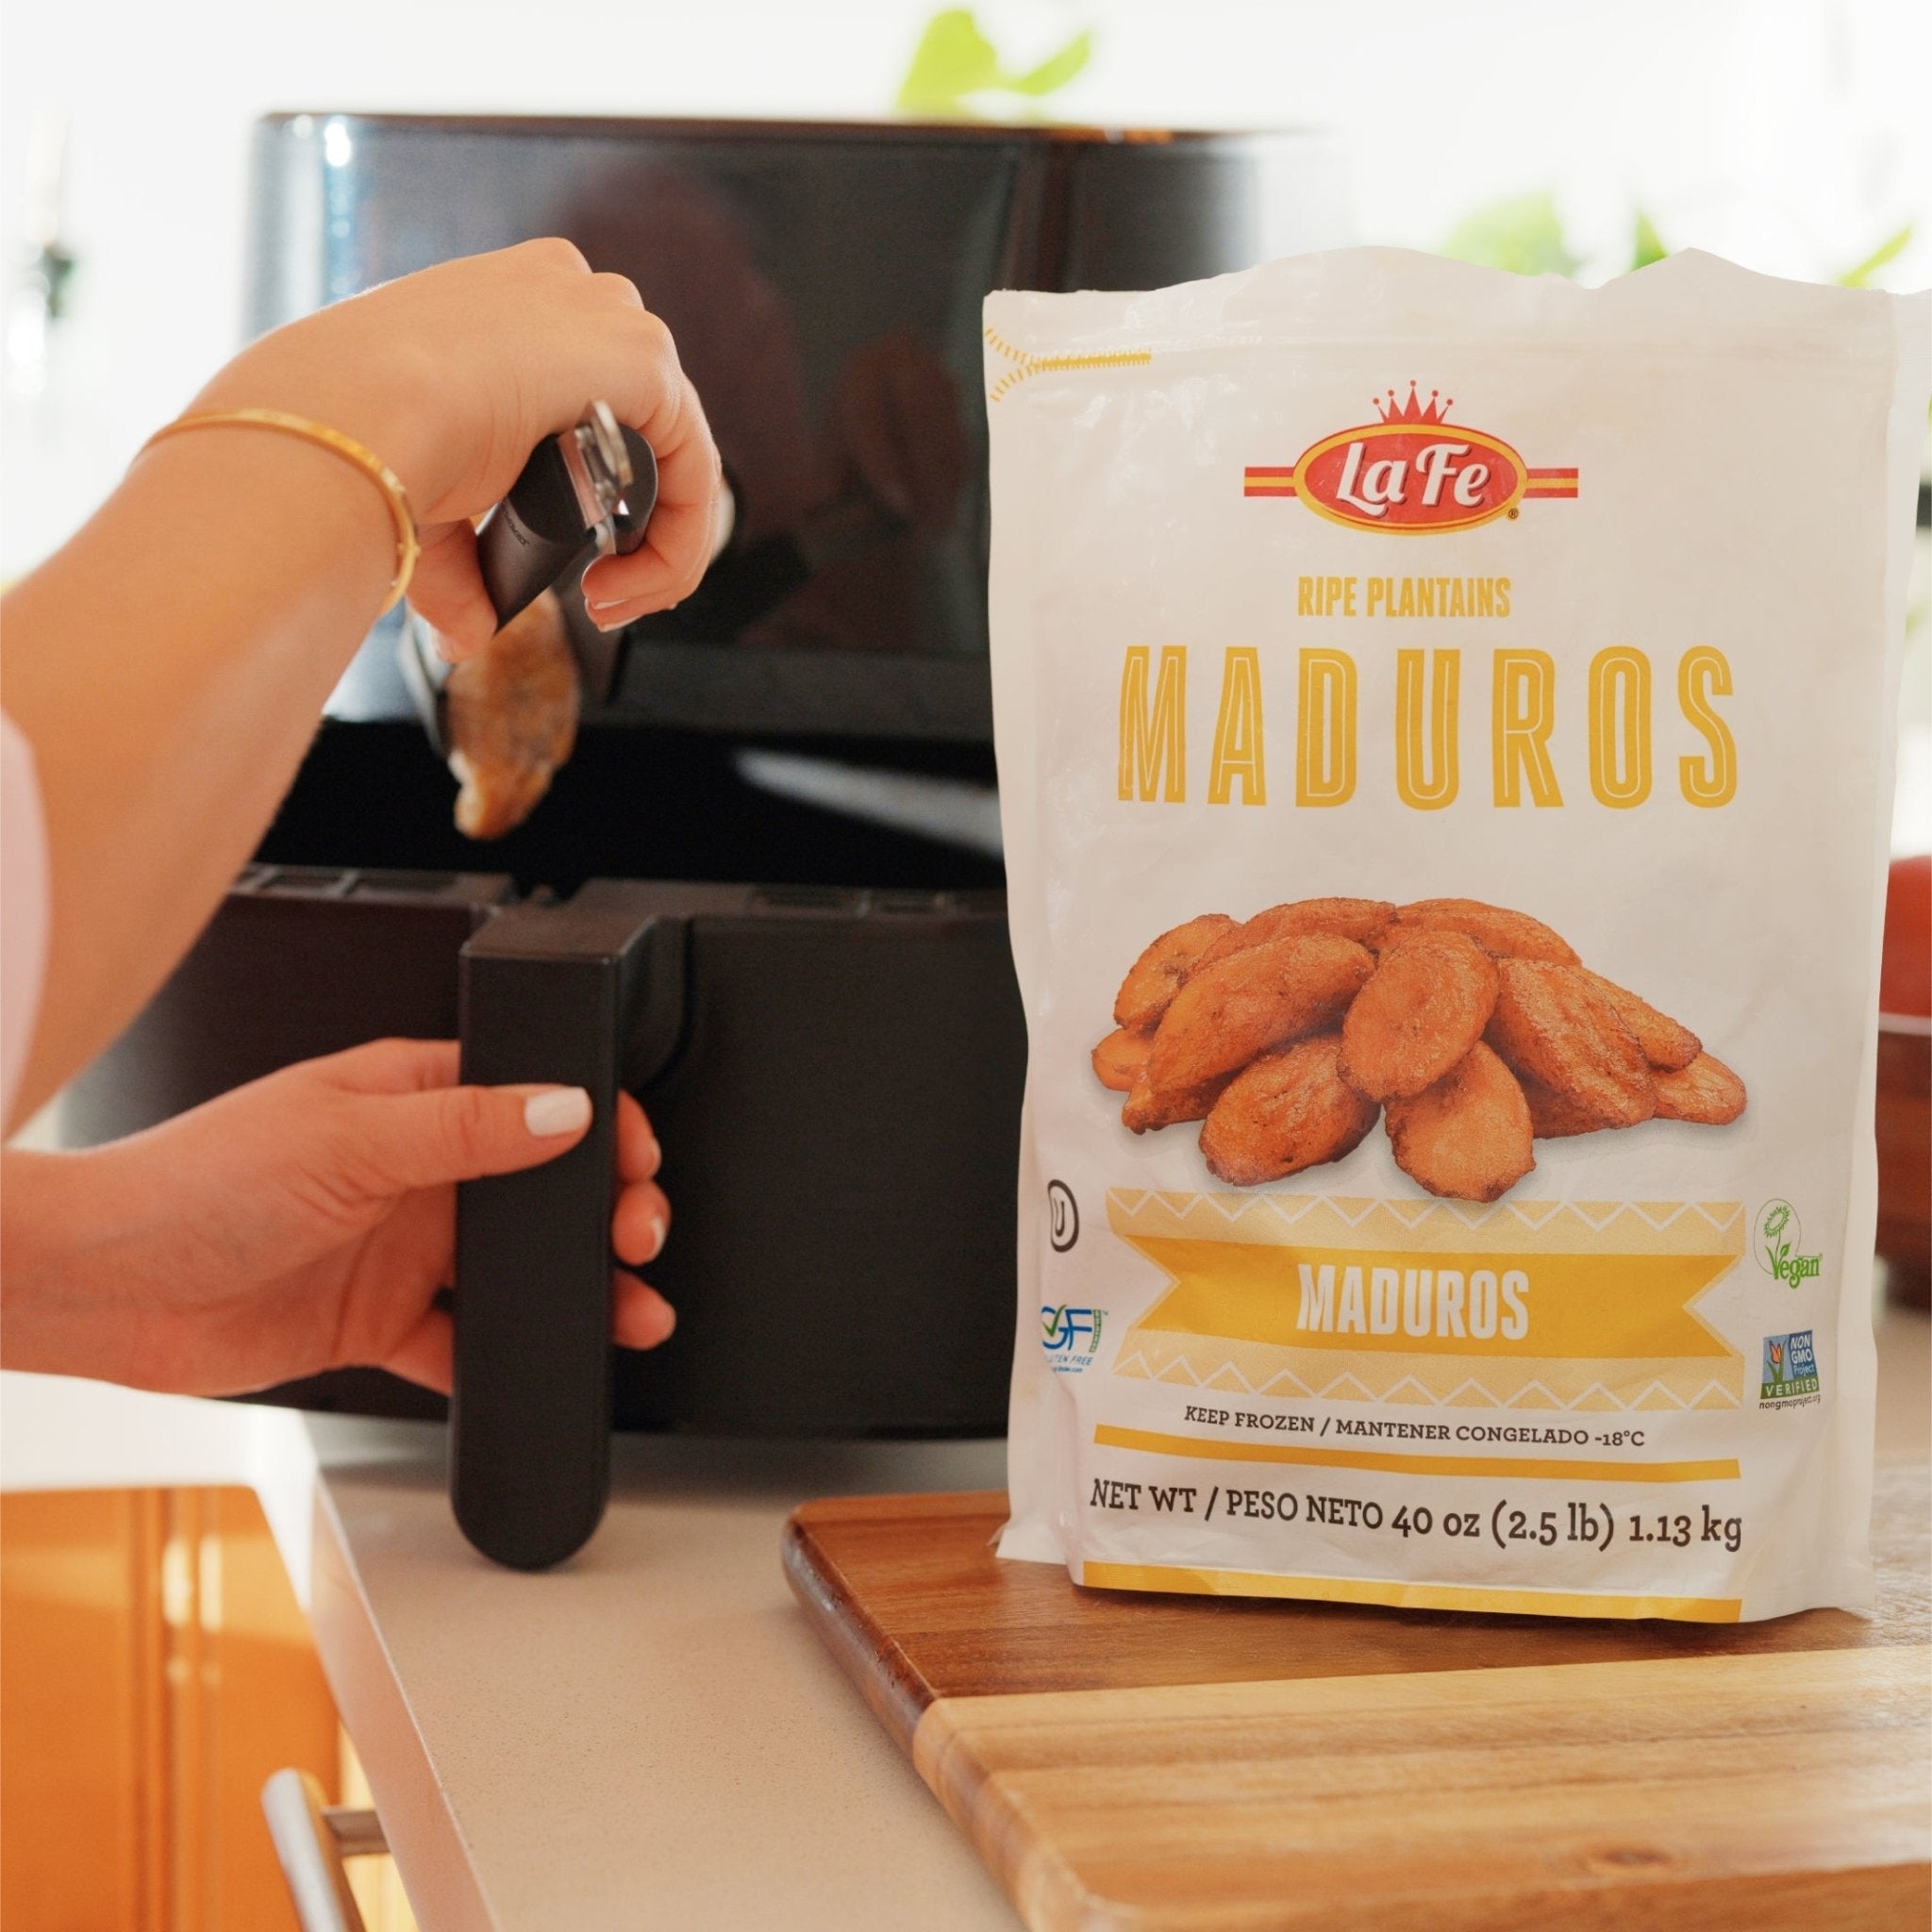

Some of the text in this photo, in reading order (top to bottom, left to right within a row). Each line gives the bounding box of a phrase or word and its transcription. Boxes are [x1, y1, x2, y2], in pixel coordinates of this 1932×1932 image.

[1336, 441, 1490, 518] La Fe
[1297, 576, 1512, 618] RIPE PLANTAINS
[1117, 644, 1738, 810] MADUROS
[1765, 1245, 1821, 1290] Vegan
[1296, 1263, 1530, 1341] MADUROS
[1071, 1355, 1093, 1366] FREE
[1790, 1335, 1811, 1350] NON
[1791, 1349, 1813, 1364] GMO
[1765, 1377, 1819, 1397] VERIFIED
[1793, 1363, 1815, 1377] Project
[1758, 1394, 1822, 1410] nongmoproject.org
[1184, 1405, 1645, 1447] KEEP FROZEN / MANTENER CONGELADO -18°C
[1090, 1477, 1742, 1552] NET WT / PESO NETO 40 oz (2.5 lb) 1.13 kg
